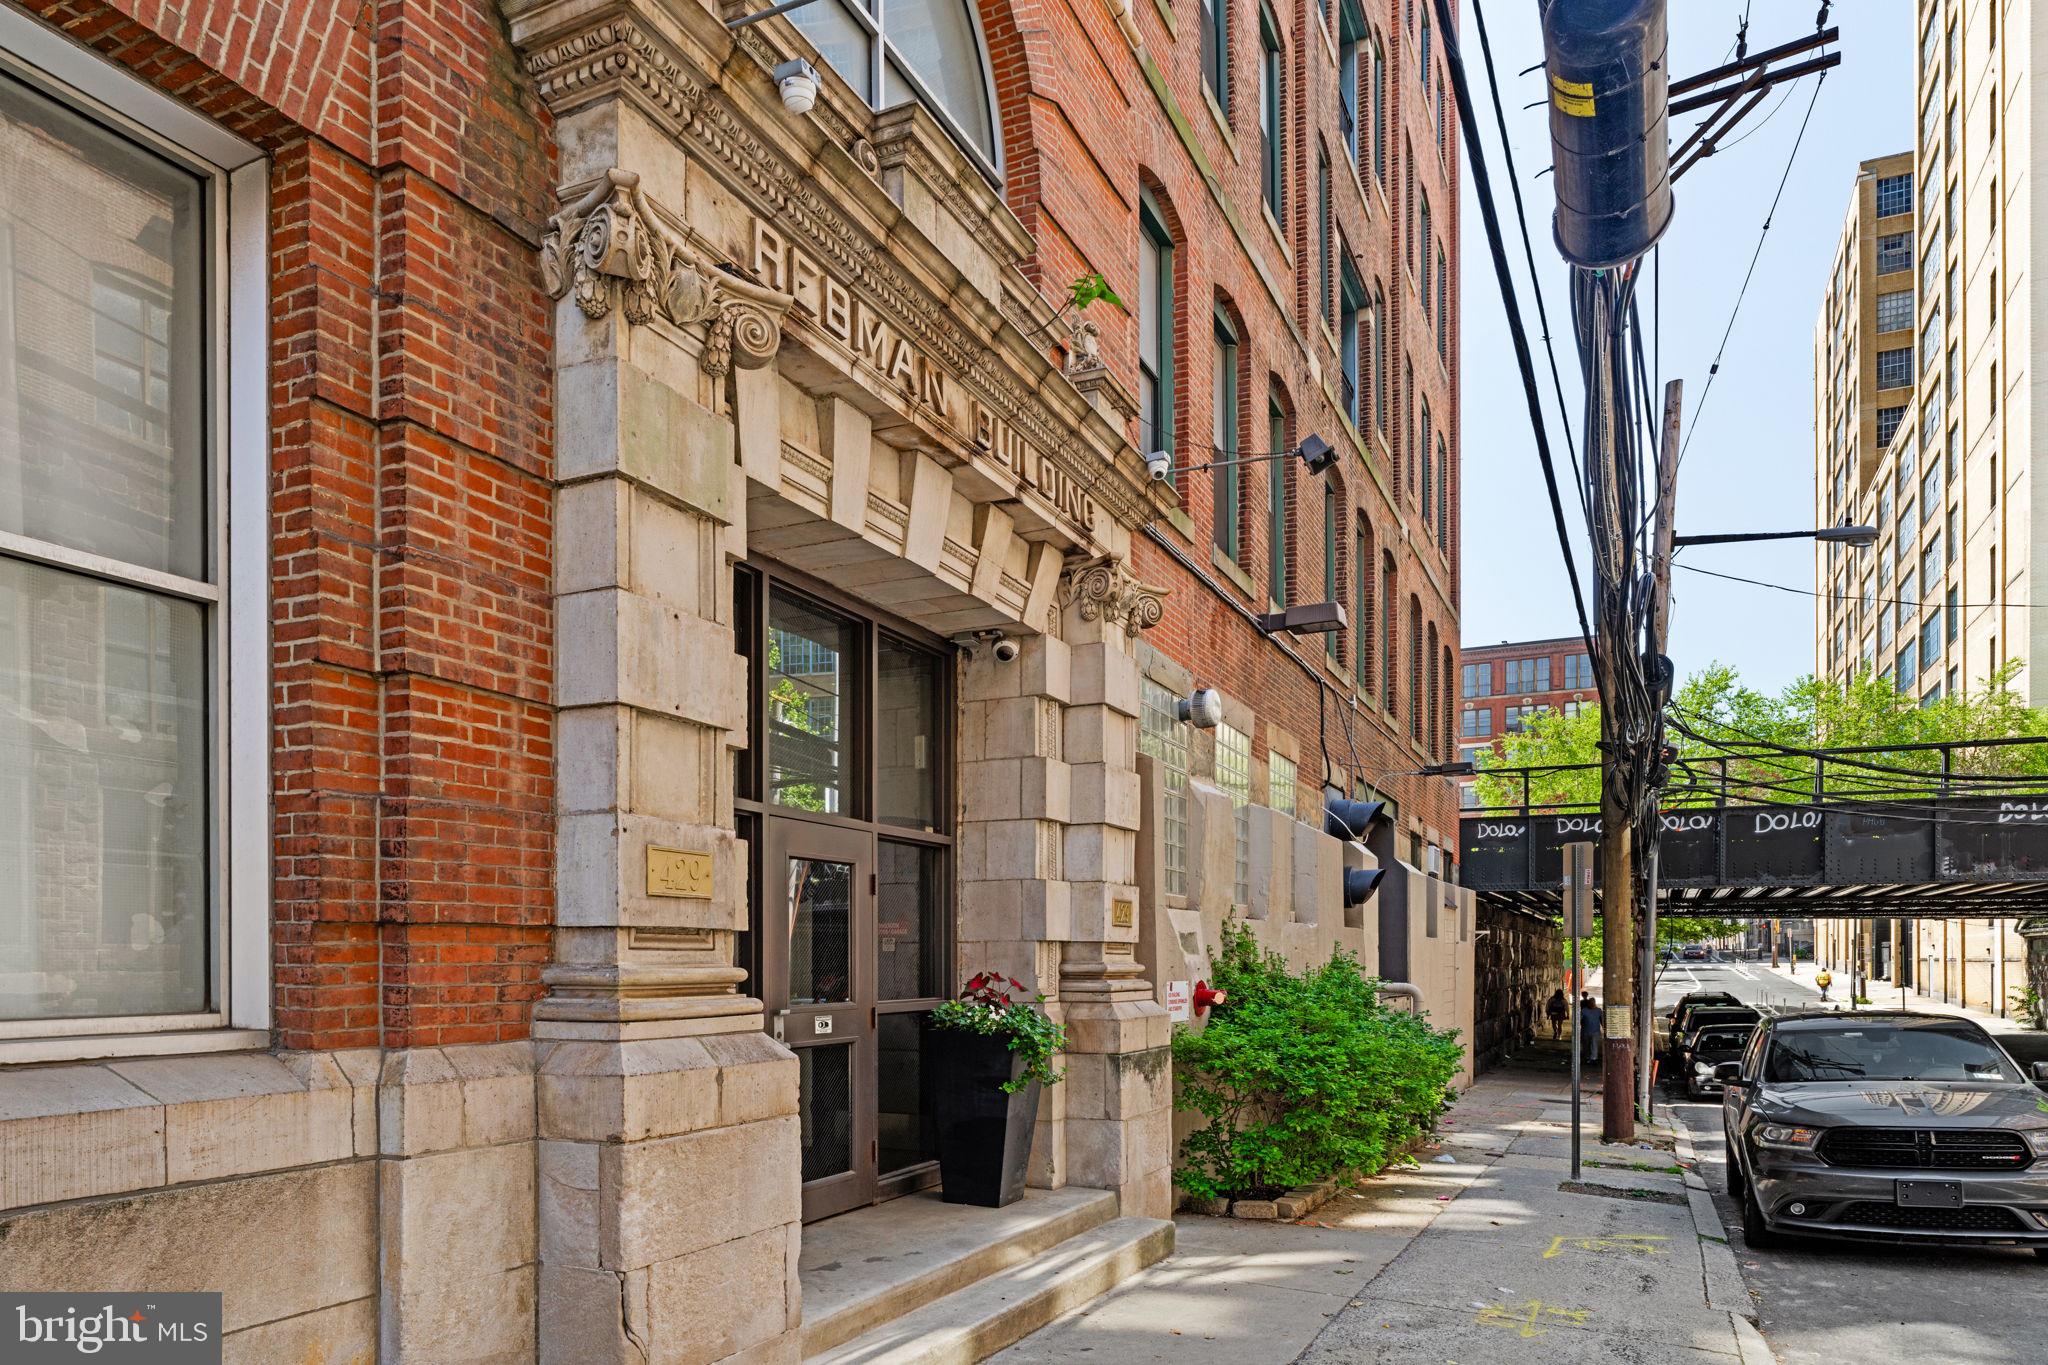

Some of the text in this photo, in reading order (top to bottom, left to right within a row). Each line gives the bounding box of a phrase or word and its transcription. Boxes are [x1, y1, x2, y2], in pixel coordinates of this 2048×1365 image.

[752, 216, 1096, 532] REBMAN BUILDING
[1478, 823, 1526, 839] DOLO!
[1755, 811, 1823, 833] DOLO!
[659, 855, 701, 892] 429
